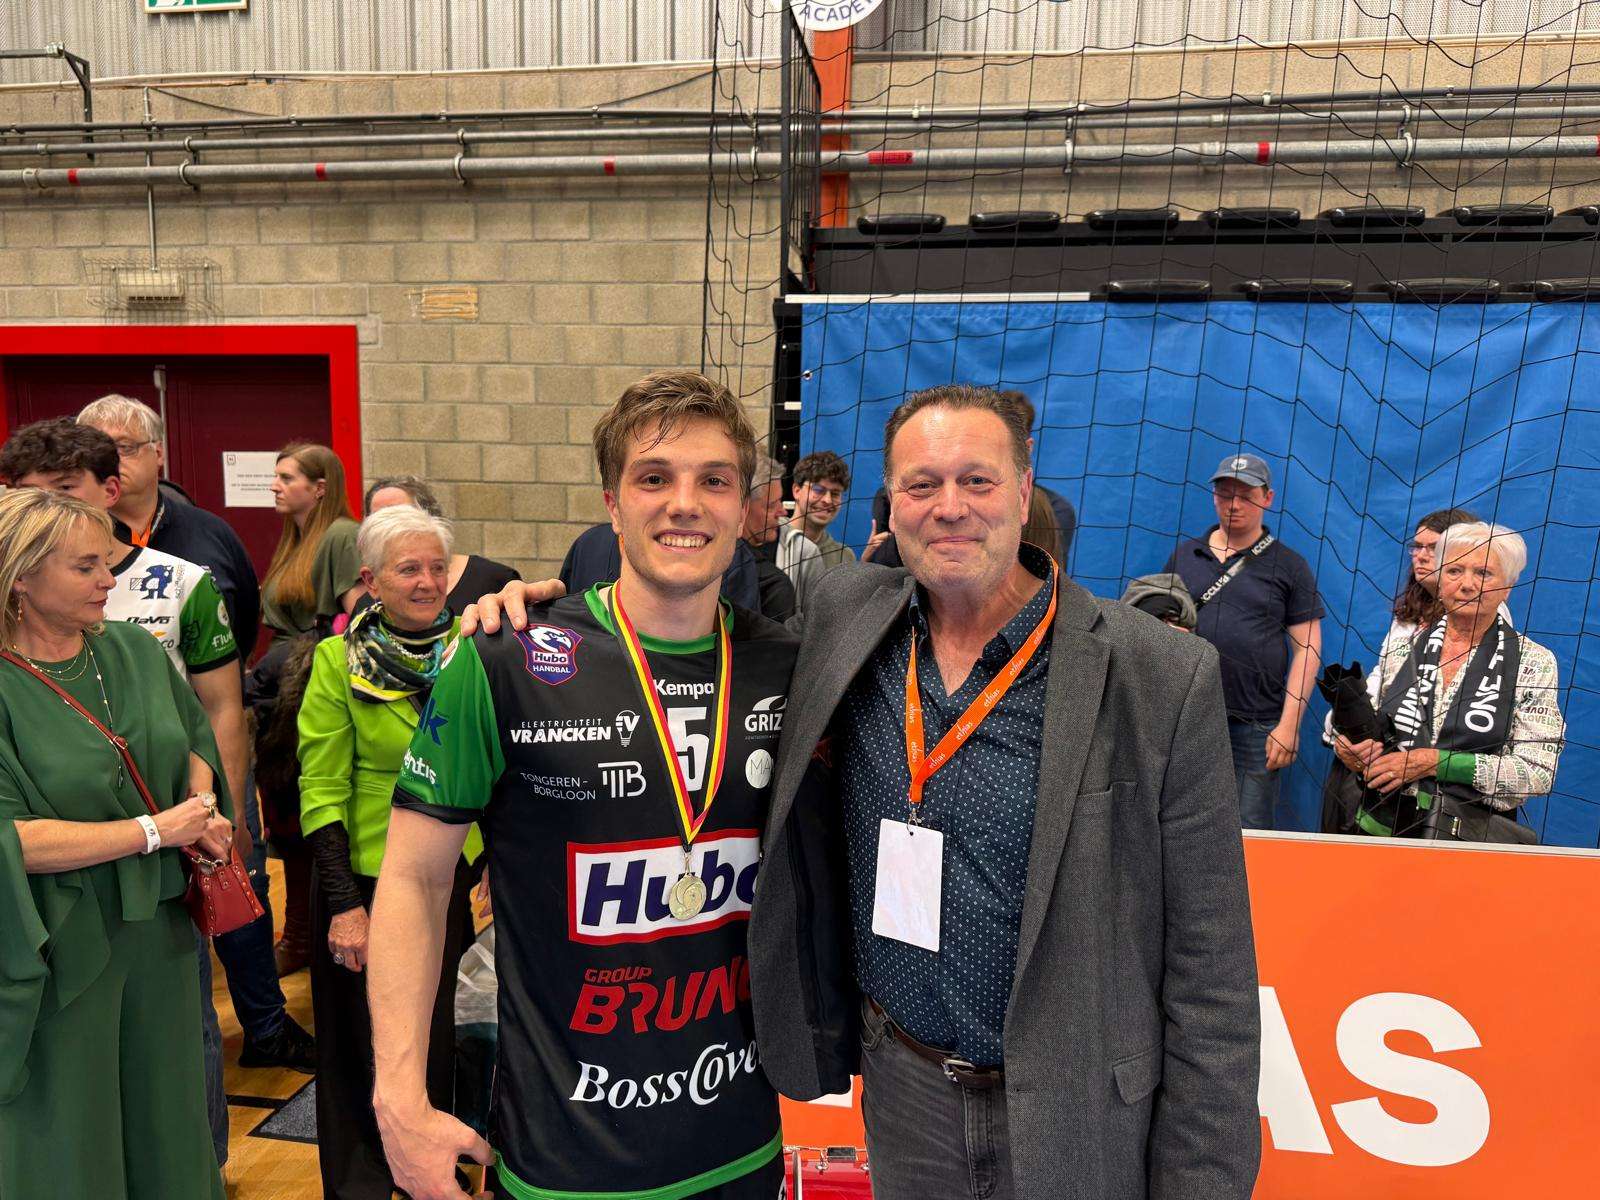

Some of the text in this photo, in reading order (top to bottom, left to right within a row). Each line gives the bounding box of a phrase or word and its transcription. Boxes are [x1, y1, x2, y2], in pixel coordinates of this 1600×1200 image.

[799, 0, 872, 21] ACADE
[534, 652, 568, 664] Hubo
[533, 664, 571, 674] HANDBAL
[653, 679, 714, 699] Kempa
[1464, 674, 1503, 733] ONE
[521, 718, 602, 728] ELEKTRICITEIT
[510, 726, 611, 743] VRANCKEN
[667, 706, 710, 792] 5
[534, 784, 596, 800] BORGLOON
[584, 966, 654, 983] GROUP
[569, 1040, 761, 1109] BossCove
